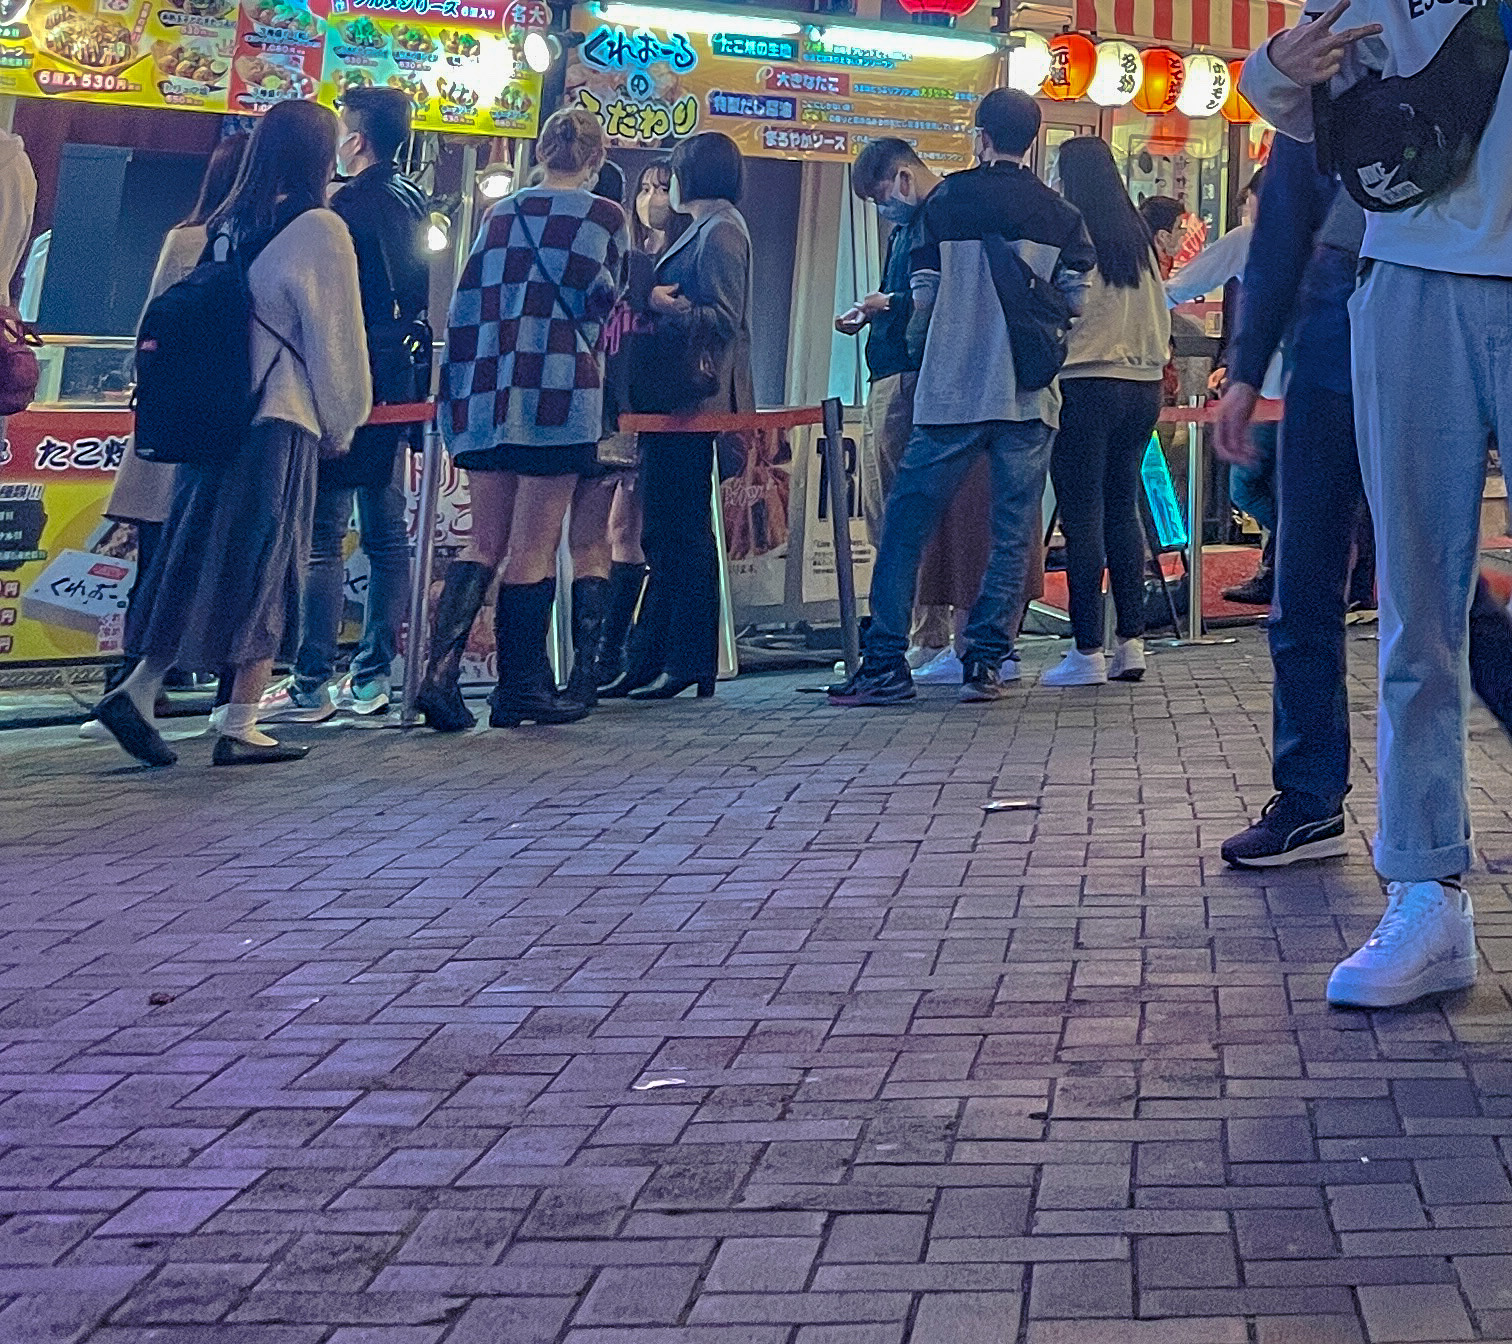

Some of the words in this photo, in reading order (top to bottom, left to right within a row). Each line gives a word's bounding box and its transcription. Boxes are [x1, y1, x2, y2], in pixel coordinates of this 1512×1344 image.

[583, 29, 697, 69] くれおーる
[630, 73, 650, 96] の
[776, 70, 840, 93] 大きなたこ
[1205, 62, 1227, 110] ホルモン
